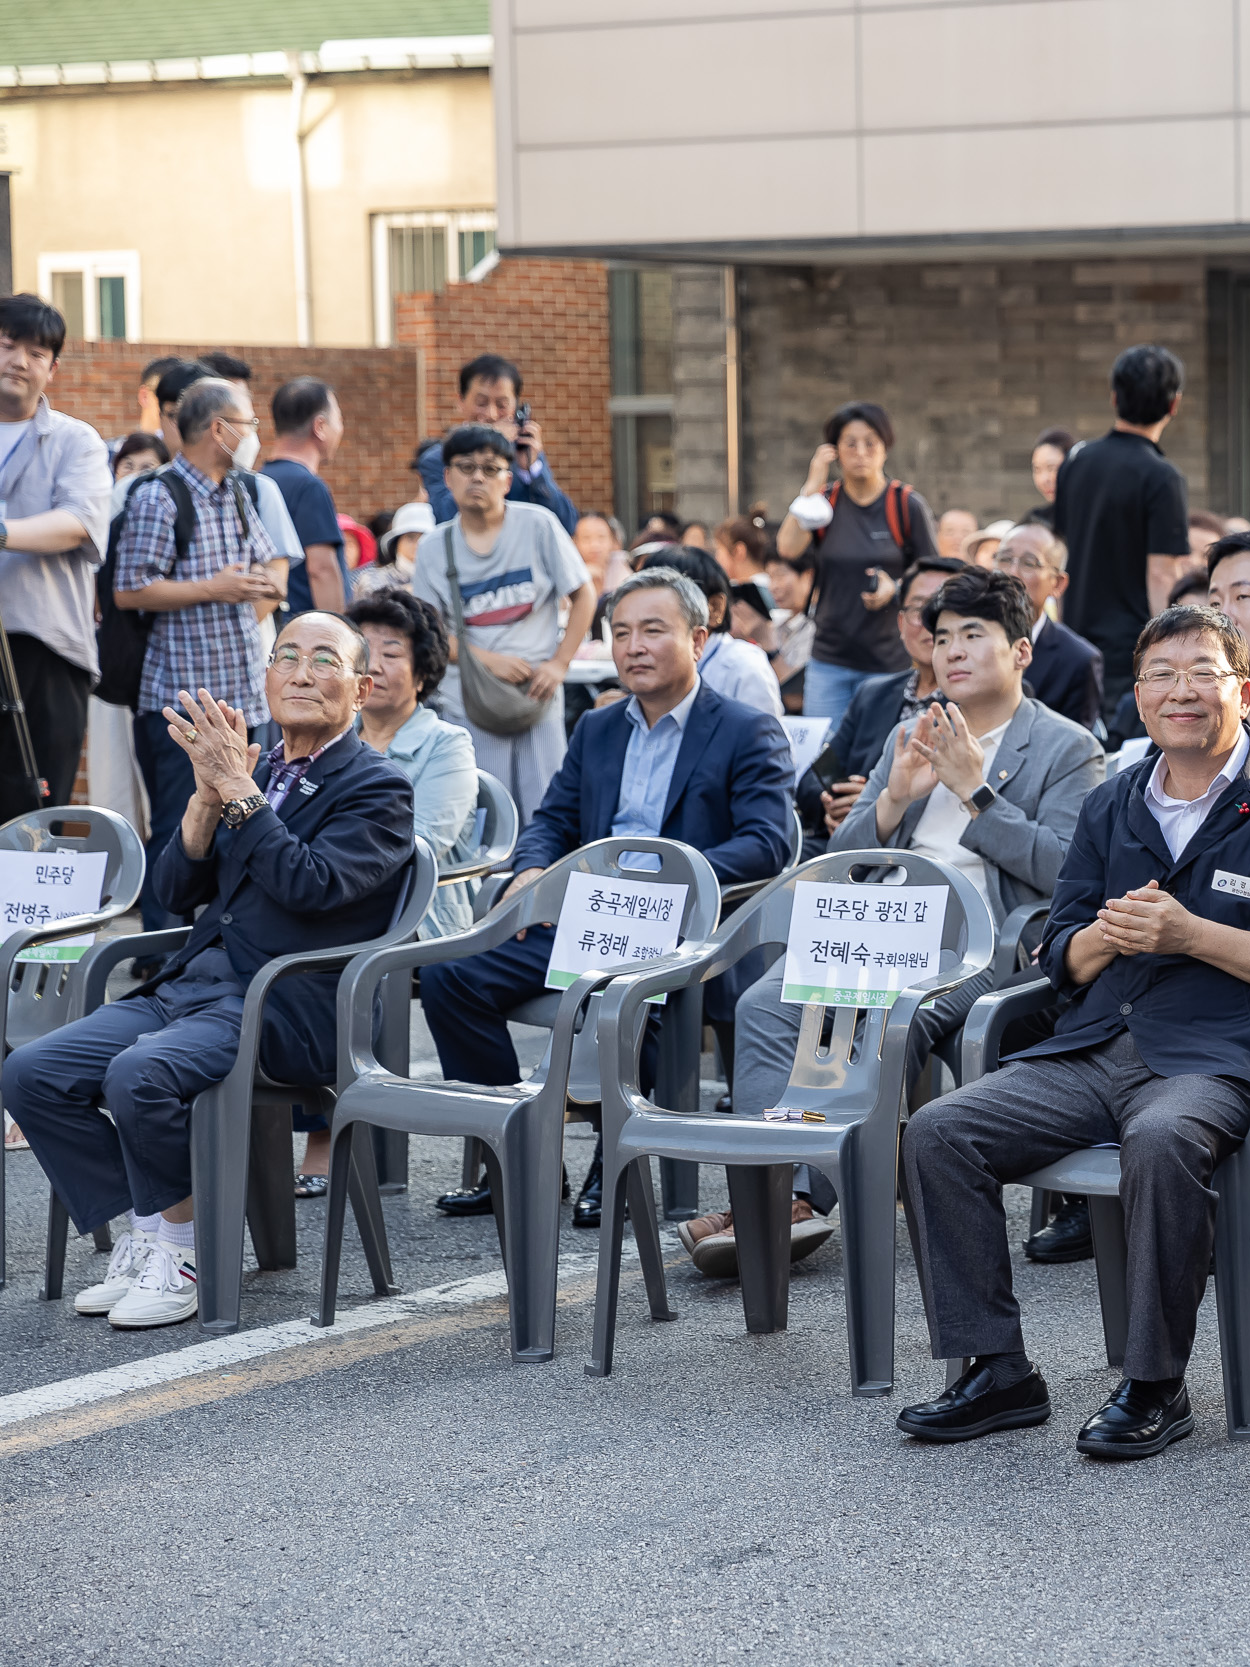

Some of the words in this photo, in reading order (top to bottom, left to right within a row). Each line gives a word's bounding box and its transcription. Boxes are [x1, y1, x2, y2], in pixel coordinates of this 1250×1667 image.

[36, 865, 75, 885] 민주당
[4, 902, 52, 925] 전병주
[588, 889, 674, 921] 중곡제일시장
[816, 897, 870, 921] 민주당
[874, 900, 907, 923] 광진
[913, 900, 928, 923] 갑
[578, 930, 630, 958] 류정래
[809, 940, 871, 967] 전혜숙
[873, 952, 929, 968] 국회의원님
[833, 990, 889, 1005] 중곡제일시장
